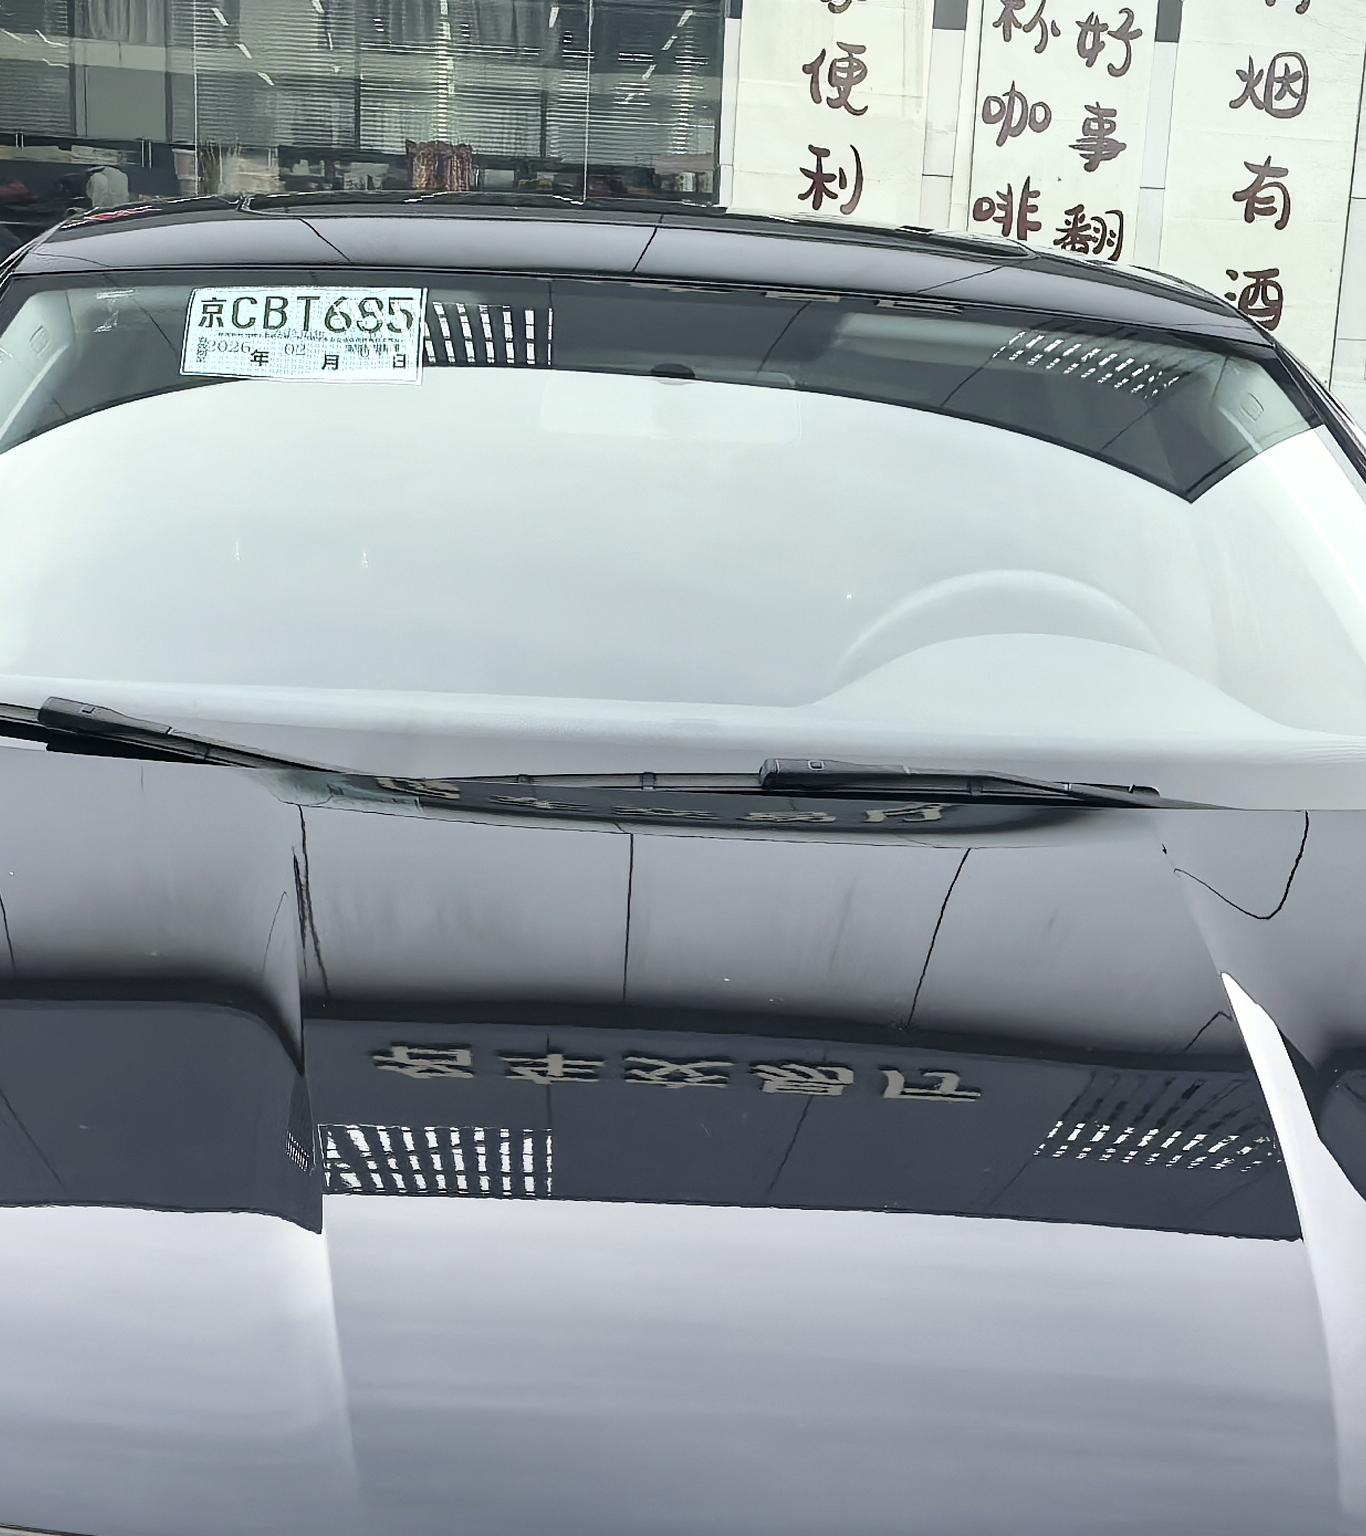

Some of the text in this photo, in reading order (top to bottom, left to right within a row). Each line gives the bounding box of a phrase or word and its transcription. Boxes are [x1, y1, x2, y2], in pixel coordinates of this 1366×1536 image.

[797, 0, 869, 216] 便利
[973, 0, 1061, 241] 杯咖啡
[1052, 7, 1143, 262] 好事翻
[1224, 0, 1310, 331] 烟有酒
